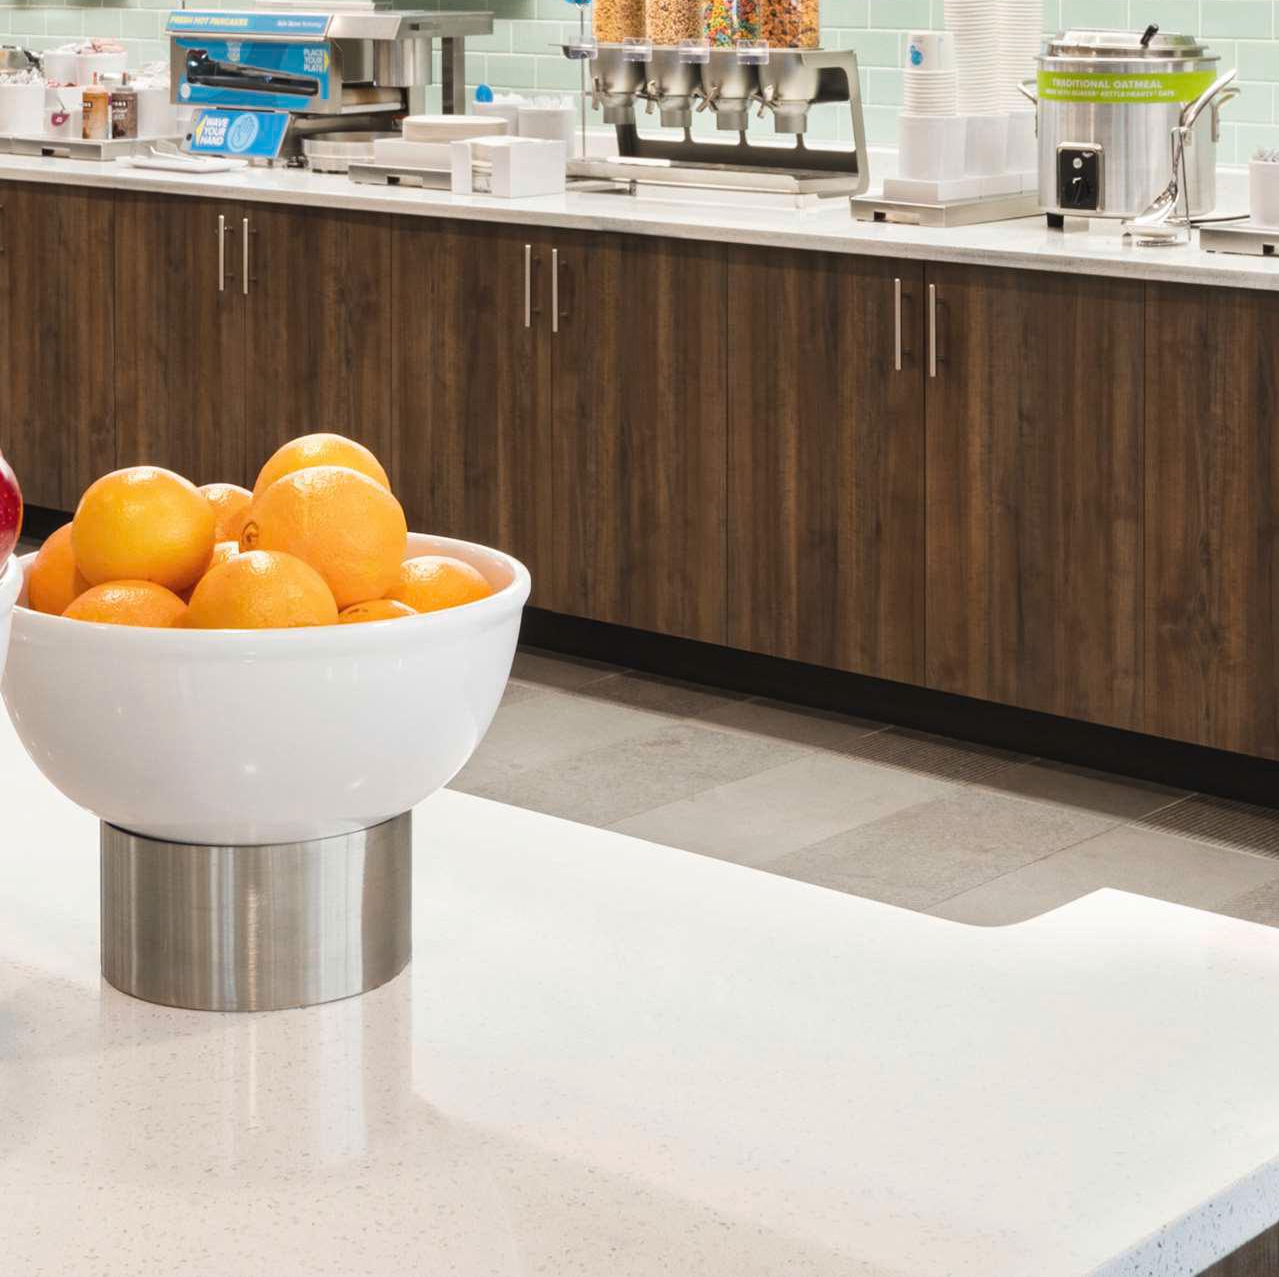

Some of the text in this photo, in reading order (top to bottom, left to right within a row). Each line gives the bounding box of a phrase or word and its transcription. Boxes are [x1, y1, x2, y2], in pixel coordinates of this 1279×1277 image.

[1052, 78, 1163, 89] TRADITIONAL OATMEAL
[207, 117, 229, 127] WAVE
[203, 126, 227, 136] YOUR
[199, 136, 224, 147] HAND
